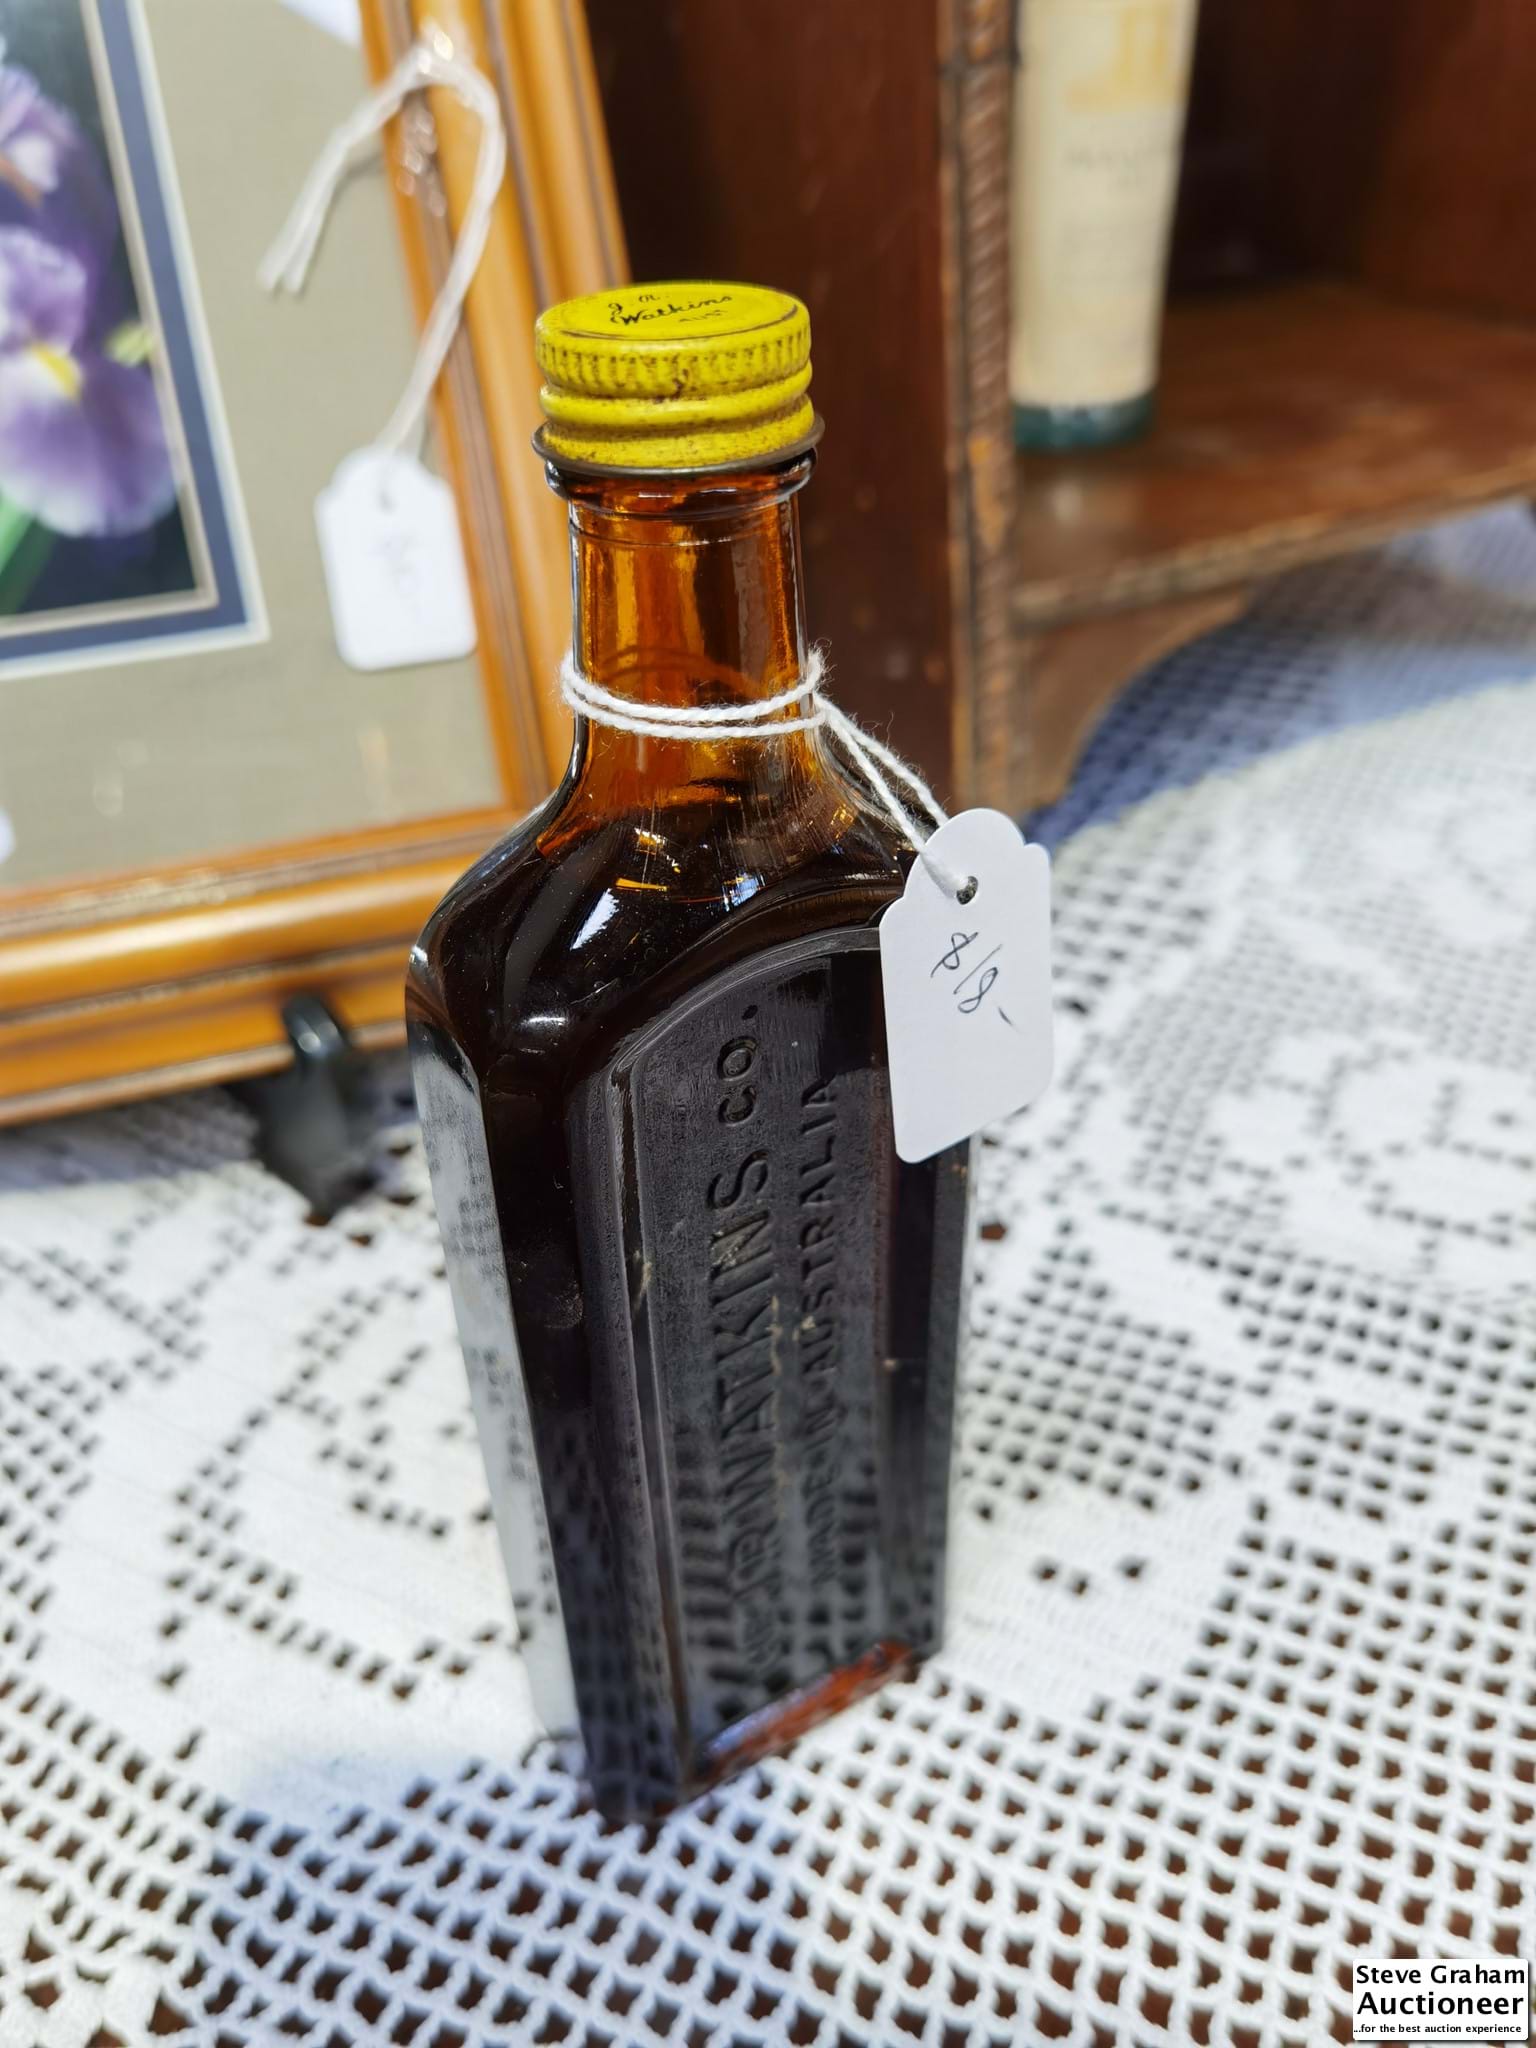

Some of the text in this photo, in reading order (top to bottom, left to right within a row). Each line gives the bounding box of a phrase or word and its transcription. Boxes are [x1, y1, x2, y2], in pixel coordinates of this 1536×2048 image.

[622, 295, 733, 325] Watkins
[716, 1004, 757, 1127] CO.
[799, 1074, 838, 1377] AUSTRALIA
[706, 1150, 777, 1522] WATKINS
